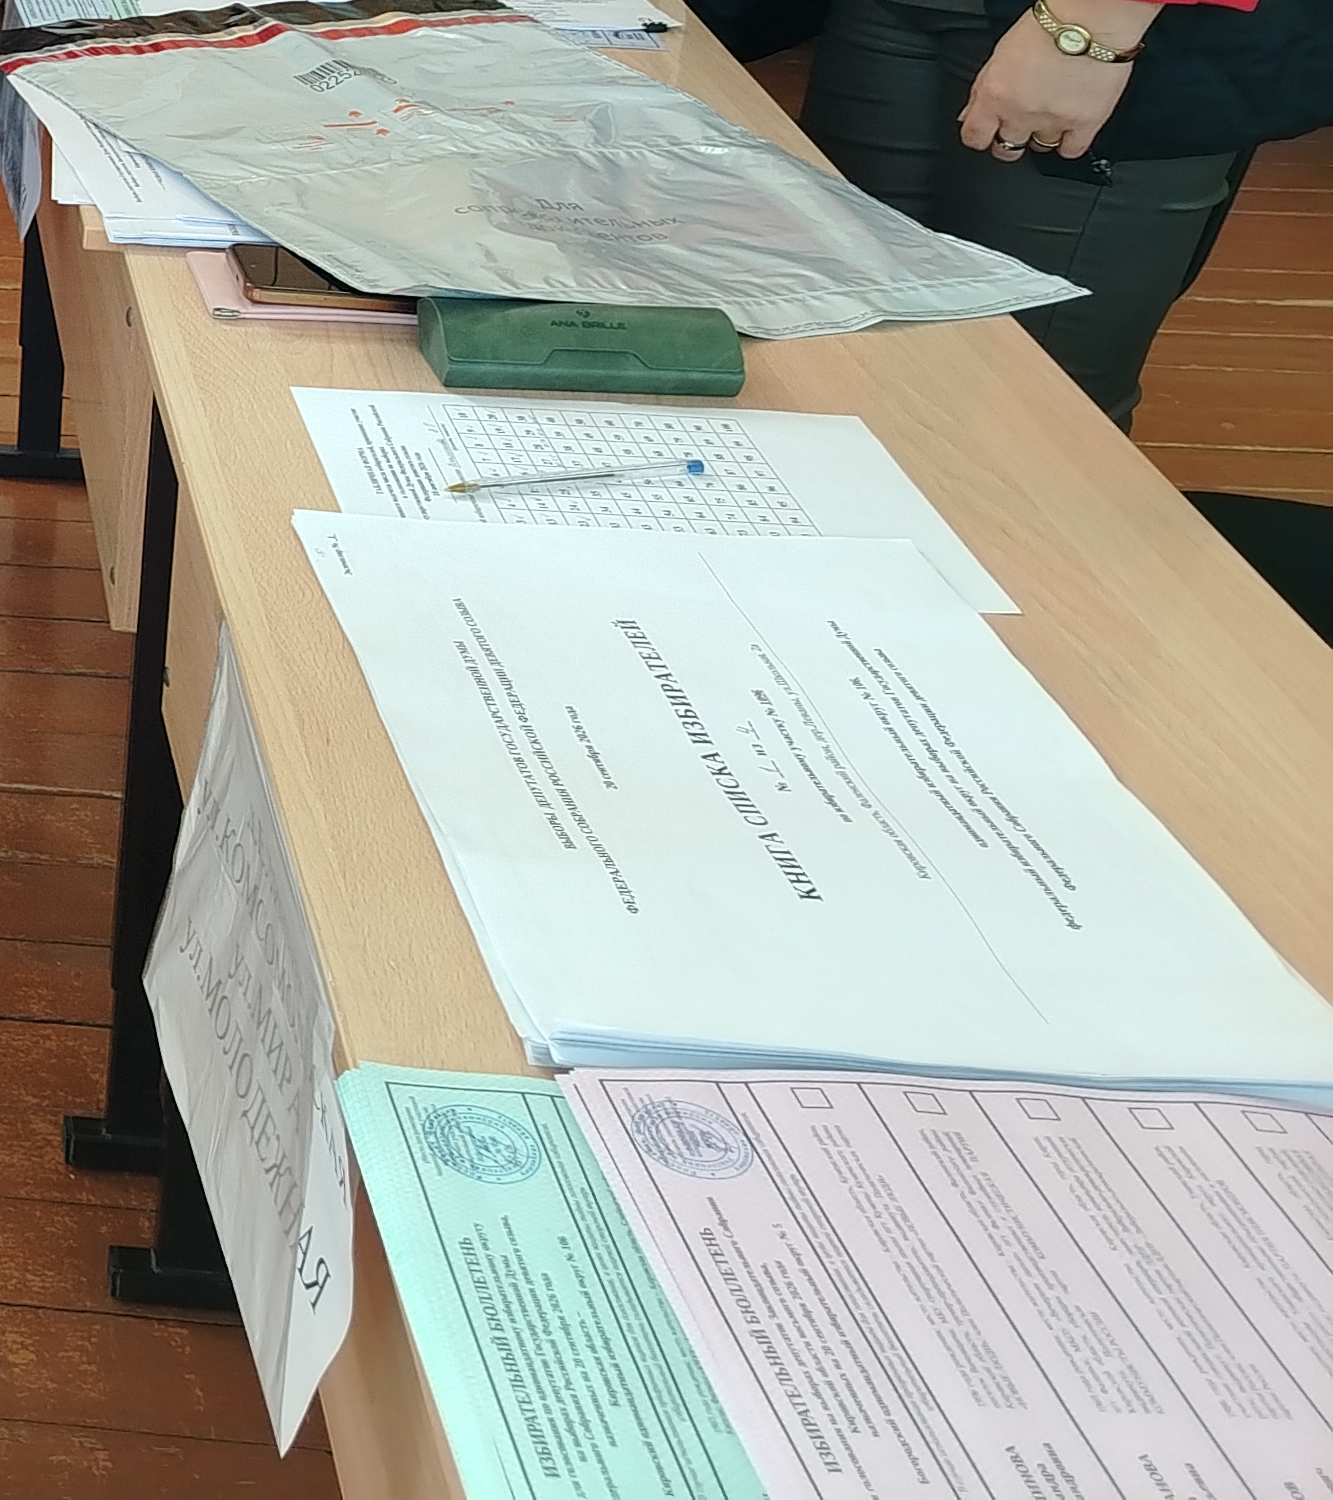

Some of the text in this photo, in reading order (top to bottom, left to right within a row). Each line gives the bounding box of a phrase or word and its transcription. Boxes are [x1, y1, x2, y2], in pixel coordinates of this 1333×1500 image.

[534, 198, 584, 211] Для
[764, 707, 779, 716] №
[861, 691, 875, 700] №
[869, 702, 891, 725] округ
[452, 597, 639, 914] ФЕДЕРАЛЬНОГО СОБРАНИЯ РОССИЙСКОЙ ФЕДЕРАЦИИ ДЕВЯТОГО СОЗЫВА
[453, 640, 577, 849] ВЫБОРЫ ДЕПУТАТОВ ГОСУДАРСТВЕННОЙ ДУМЫ
[564, 705, 619, 789] 20 сентября 2026 года
[611, 619, 823, 901] КНИГА СПИСКА ИЗБИРАТЕЛЕЙ
[751, 743, 767, 756] из
[772, 718, 803, 751] участку
[820, 744, 847, 769] район,
[882, 726, 937, 787] избирательный
[774, 781, 792, 792] №
[793, 752, 845, 812] избирательному
[827, 620, 1083, 930] федеральный избирательный округ на выборах депутатов Государственной Думы
[834, 770, 873, 808] Фаленский
[873, 648, 1077, 890] Федерального Собрания Российской Федерации девятого созыва
[839, 813, 853, 822] по
[871, 809, 899, 837] область,
[929, 789, 989, 847] одномандатный
[893, 839, 932, 879] Кировская
[180, 916, 331, 1315] ул.МОЛОДЕЖНАЯ
[473, 1222, 491, 1251] округу
[557, 1235, 572, 1250] 106
[564, 1252, 576, 1262] №
[779, 1230, 789, 1239] №
[784, 1242, 805, 1266] округ
[484, 1252, 518, 1323] избирательному
[512, 1247, 534, 1285] девятого
[570, 1263, 588, 1288] округ
[699, 1227, 761, 1324] БЮЛЛЕТЕНЬ
[527, 1287, 553, 1337] Федерации
[578, 1290, 617, 1360] избирательный
[778, 1297, 808, 1338] восьмого
[798, 1268, 847, 1337] избирательный
[458, 1237, 561, 1478] ИЗБИРАТЕЛЬНЫЙ БЮЛЛЕТЕНЬ
[499, 1254, 588, 1462] на выборах депутатов Государственной Думы
[540, 1272, 618, 1447] назначенных на 20 сентября 2026 года
[578, 1318, 599, 1354] область
[706, 1196, 875, 1491] голосования на выборах депутатов Законодательного Собрания
[774, 1260, 880, 1437] назначенных на 20 сентября 2026 года
[802, 1340, 830, 1377] области
[511, 1325, 547, 1401] одномандатному
[544, 1338, 576, 1391] Российской
[592, 1355, 622, 1407] Кировская
[840, 1339, 892, 1416] одномандатный
[541, 1402, 553, 1415] по
[569, 1393, 596, 1440] Собрания
[609, 1362, 650, 1439] одномандатный
[748, 1329, 843, 1473] ИЗБИРАТЕЛЬНЫЙ
[823, 1379, 862, 1433] Кировской
[546, 1416, 577, 1477] голосования
[641, 1440, 676, 1496] Кировский
[884, 1418, 931, 1484] Богородский
